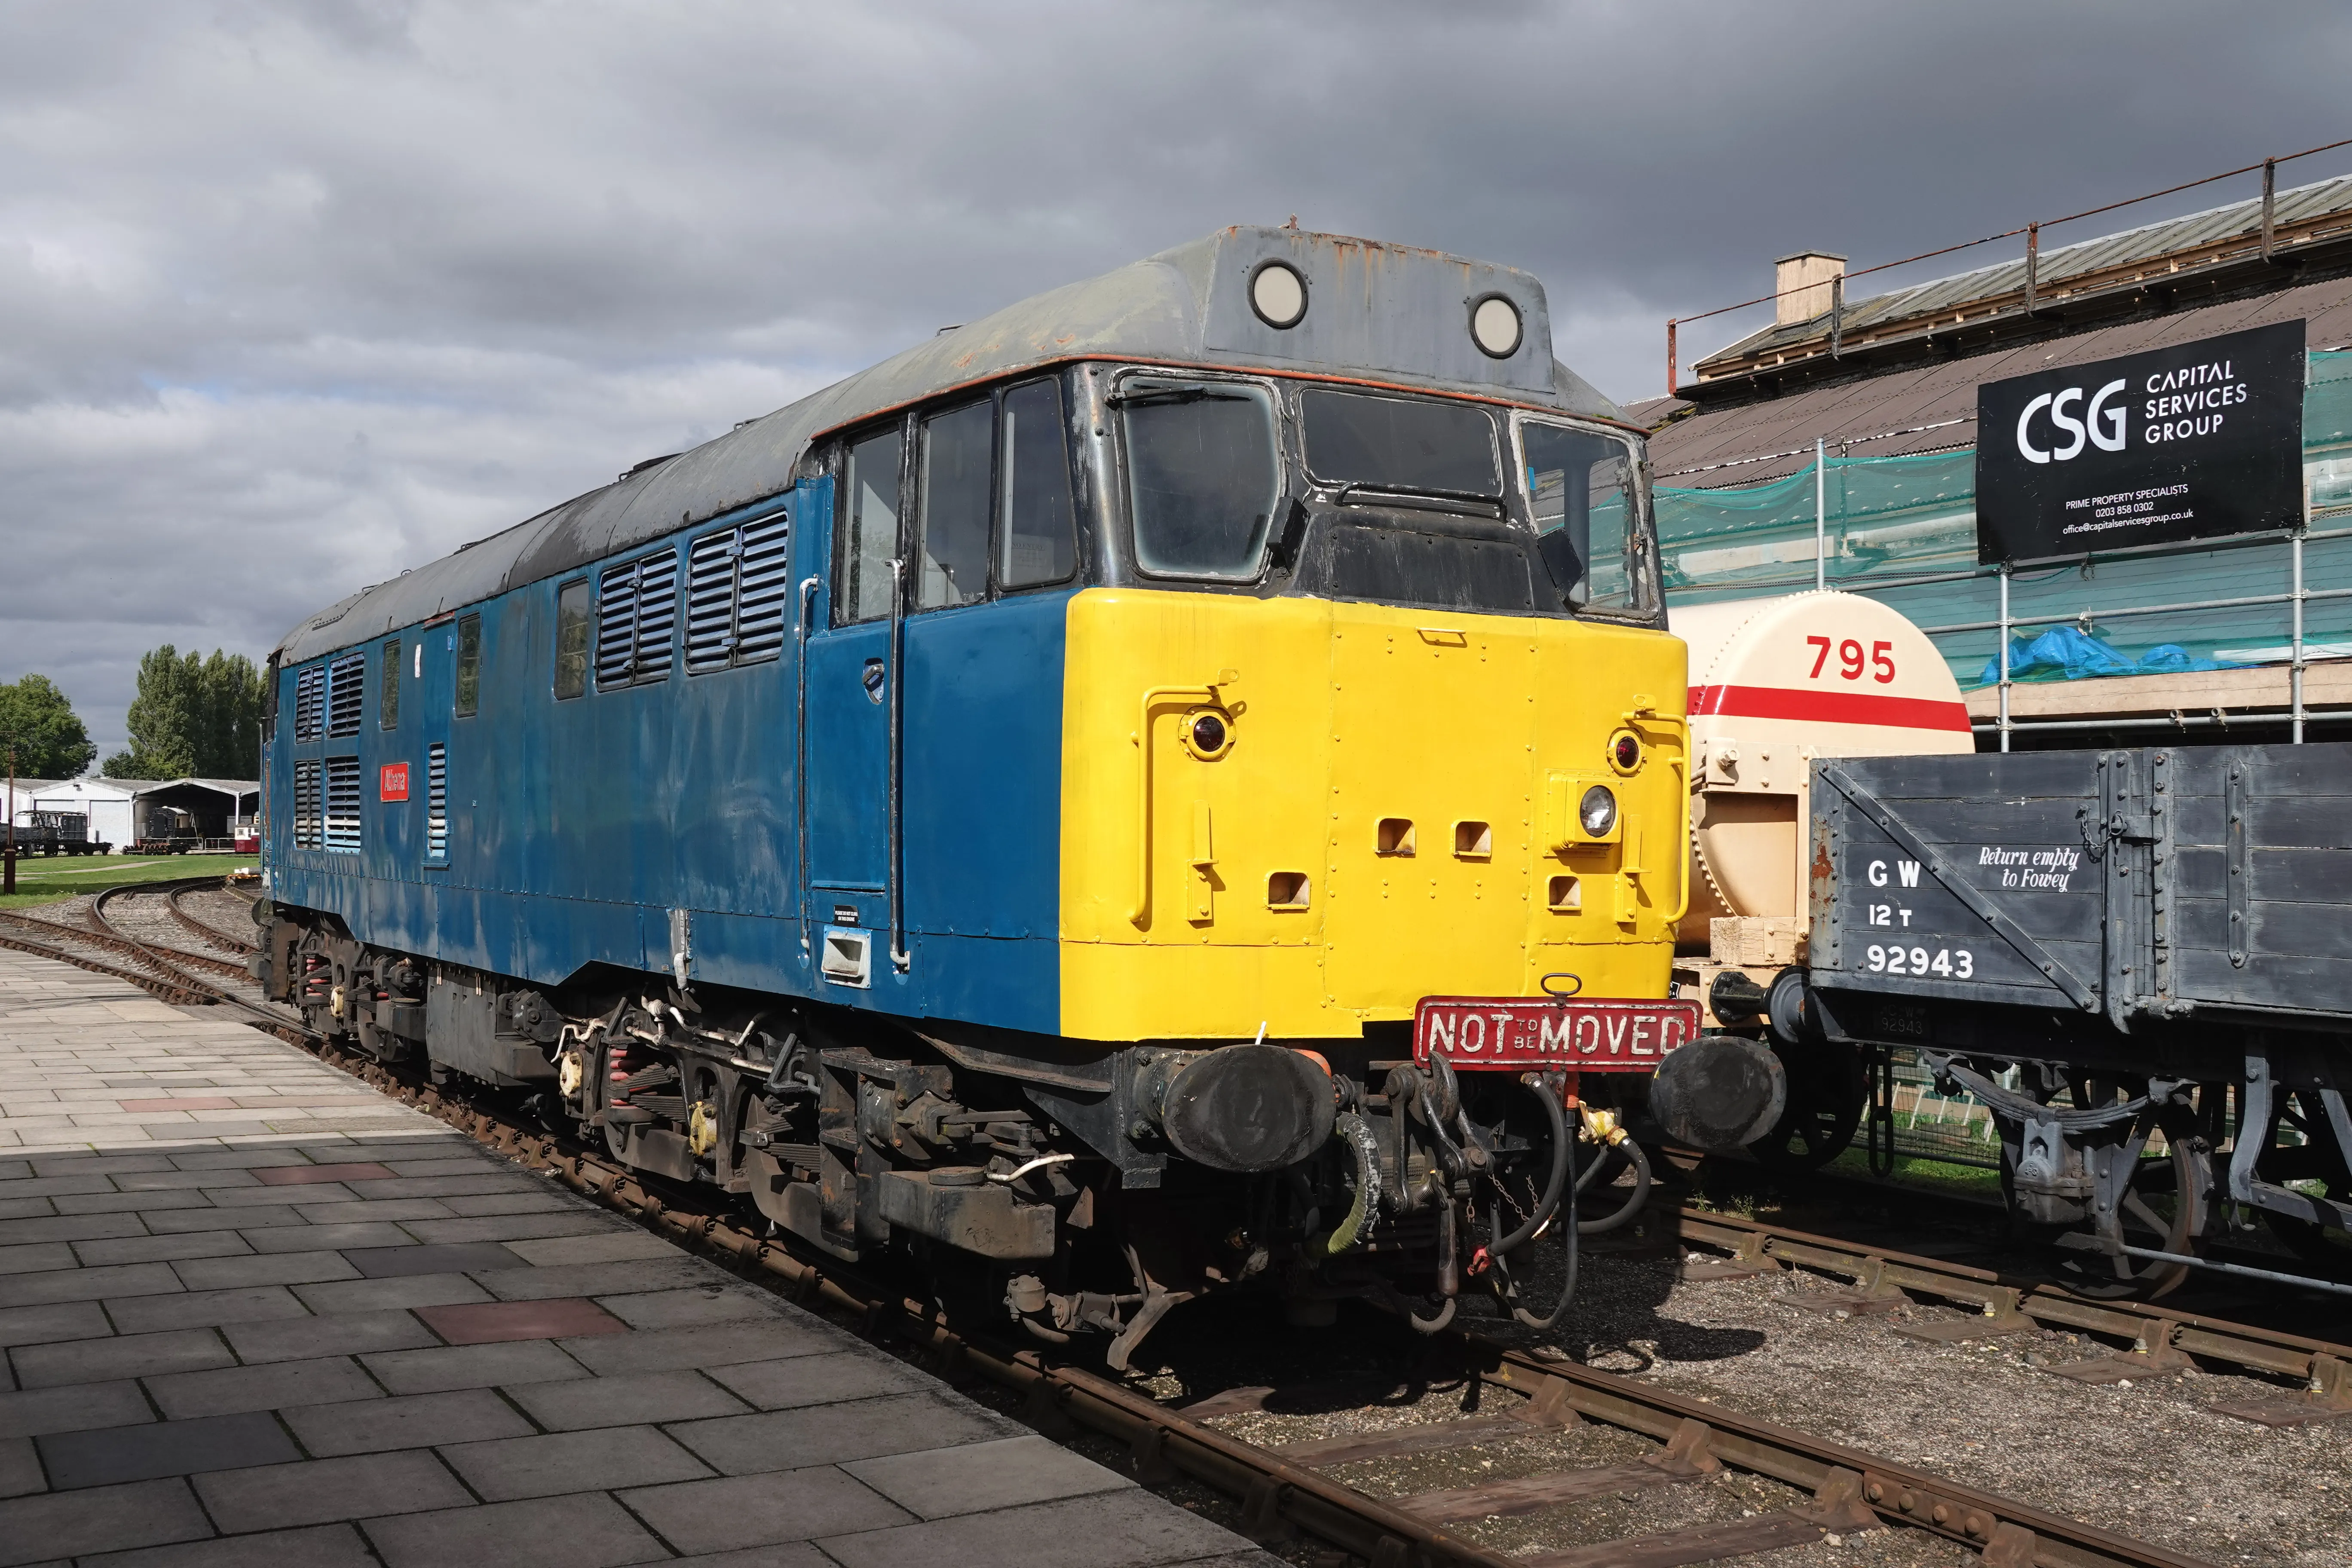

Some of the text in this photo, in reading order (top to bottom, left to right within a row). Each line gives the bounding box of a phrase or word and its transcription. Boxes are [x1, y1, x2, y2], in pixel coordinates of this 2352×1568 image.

[2147, 361, 2234, 394] CAPITAL
[2145, 383, 2247, 420] SERVICES
[2017, 379, 2126, 464] CSG
[2145, 414, 2223, 444] GROUP
[2066, 484, 2189, 510] PRIME PROPERTY SPECIALISTS
[2095, 502, 2154, 518] 0203 858 0302
[2063, 508, 2193, 534] office@capitalservicesgroup.co.uk
[1807, 635, 1895, 683] 795
[384, 769, 405, 792] Athena
[1978, 847, 2080, 873] Return empty
[1868, 860, 1920, 888] G W
[2002, 868, 2070, 893] to Fowey
[1869, 904, 1912, 927] 12 T
[1867, 945, 1973, 979] 92943
[1429, 1014, 1686, 1055] NOT TO BE MOVED
[1882, 1017, 1922, 1034] 92943
